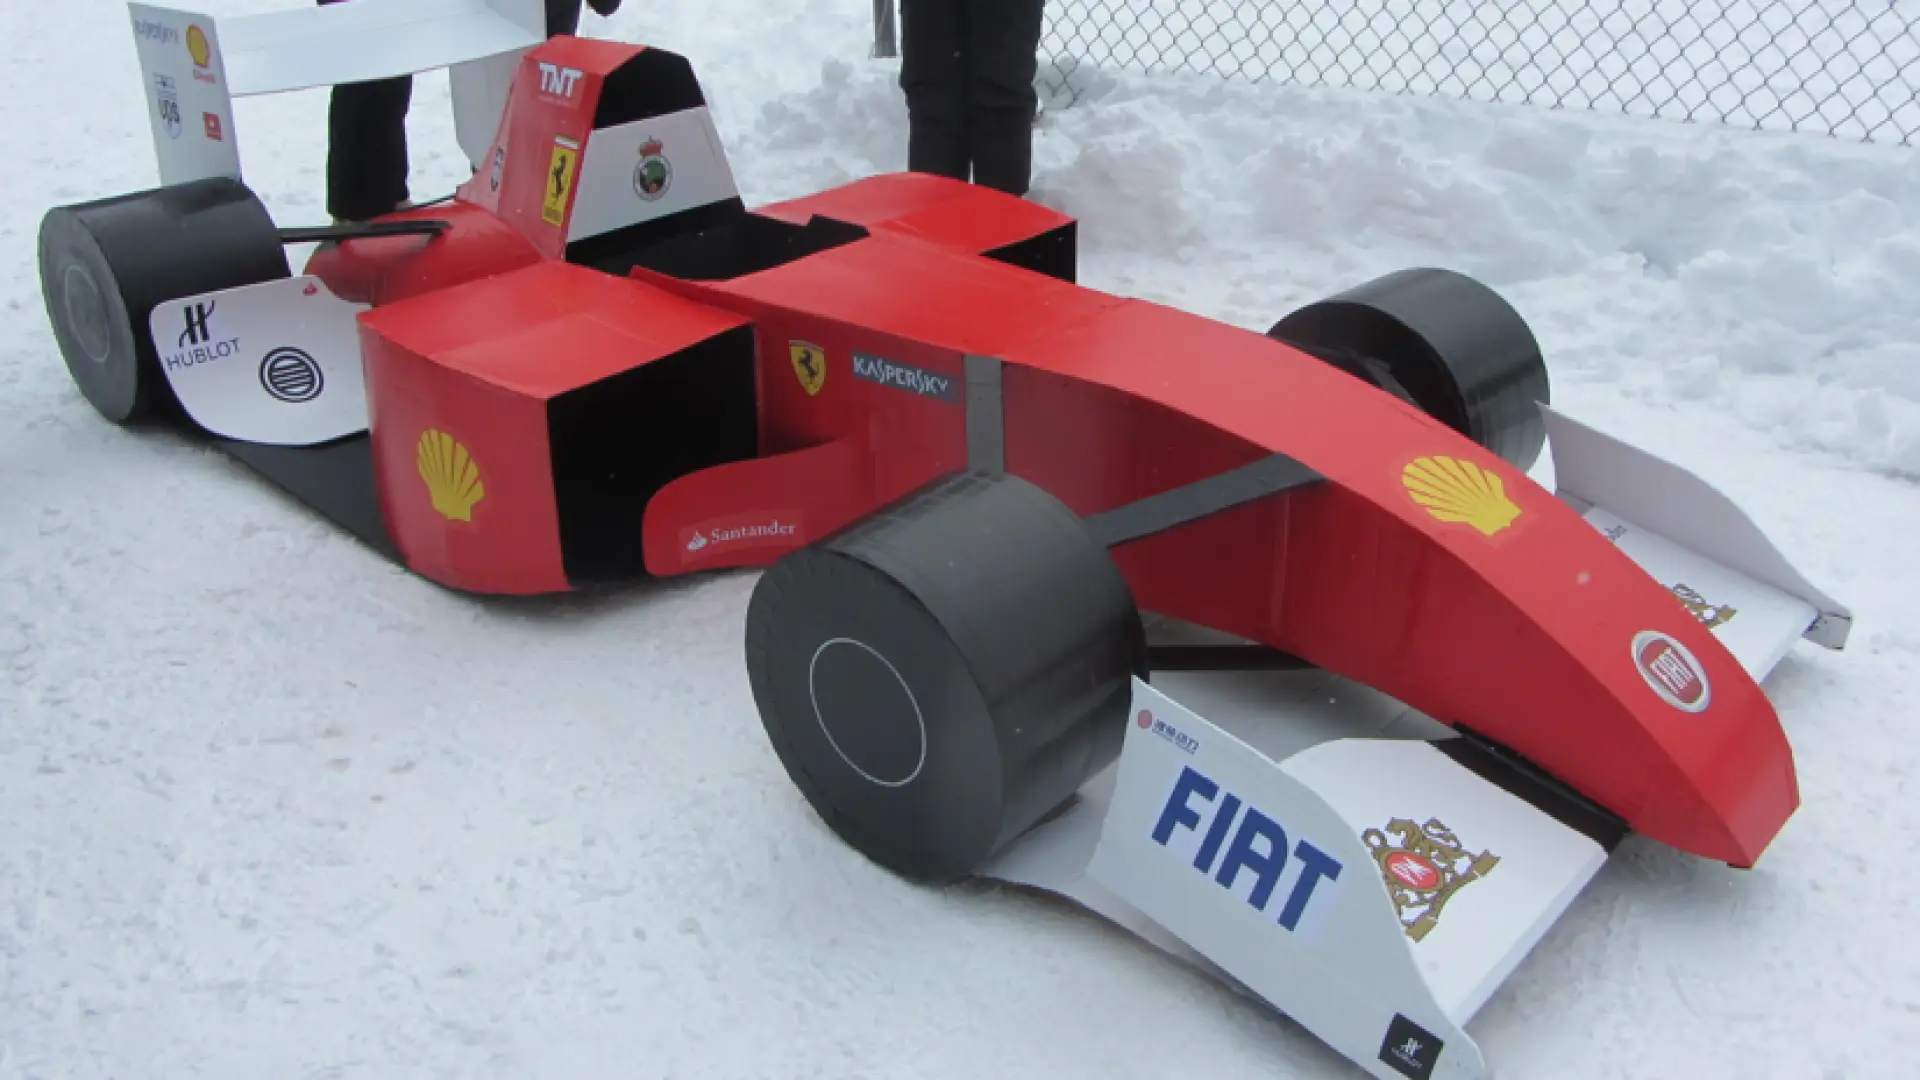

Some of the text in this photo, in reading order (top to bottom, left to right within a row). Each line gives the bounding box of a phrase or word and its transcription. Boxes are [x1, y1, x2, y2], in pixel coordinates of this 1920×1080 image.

[539, 62, 583, 98] TNT
[166, 338, 240, 370] HUBLOT
[853, 355, 948, 394] KASPERSKY
[711, 519, 796, 544] Santander
[1151, 765, 1343, 932] FIAT
